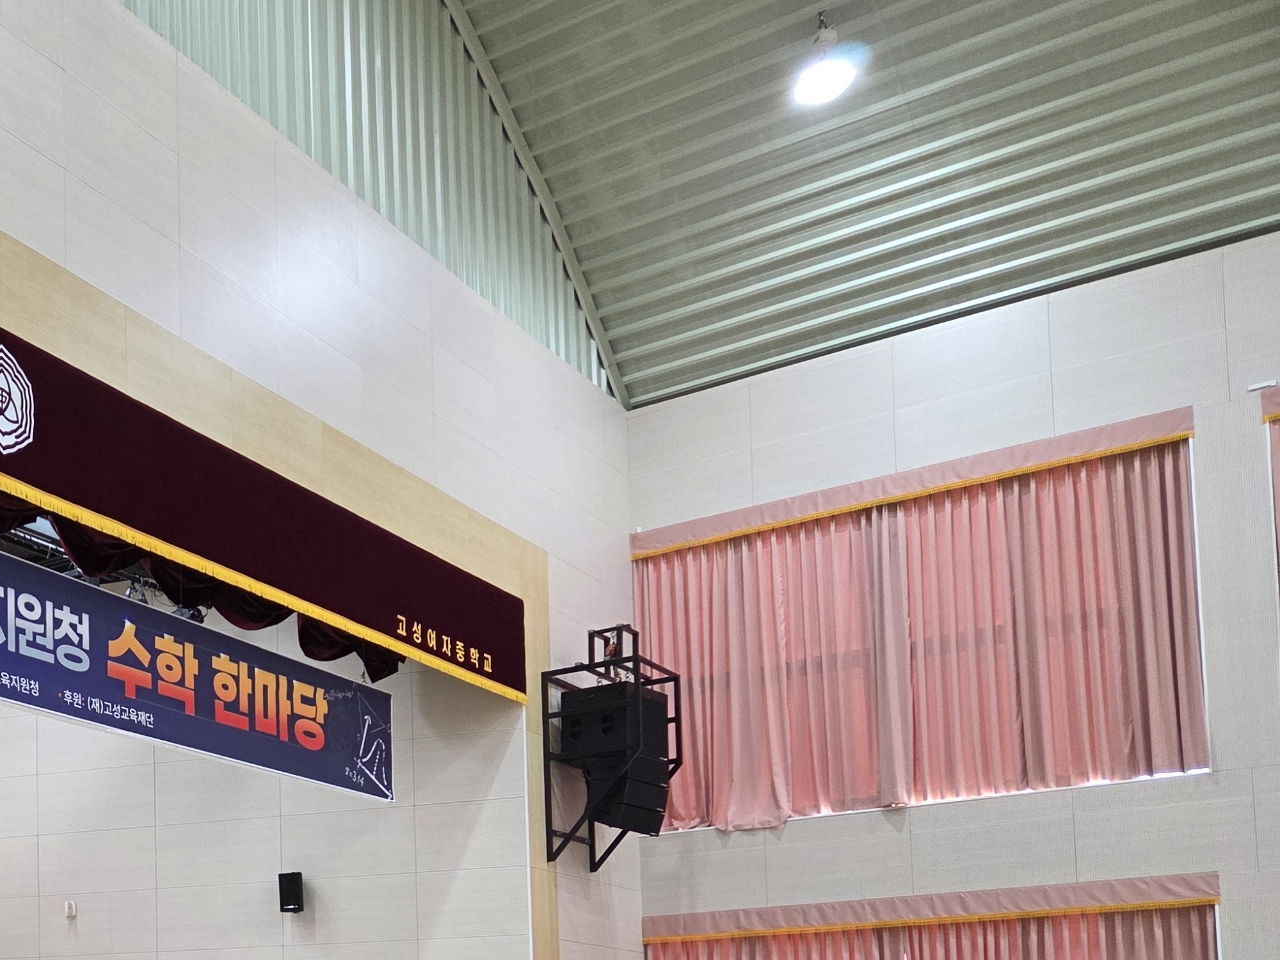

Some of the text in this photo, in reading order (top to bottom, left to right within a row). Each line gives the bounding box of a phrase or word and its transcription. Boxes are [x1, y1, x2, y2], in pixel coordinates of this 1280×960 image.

[396, 614, 493, 673] 고성여자중학교
[87, 696, 154, 728] (재)고성교육재단
[107, 619, 329, 751] 수학 한마당
